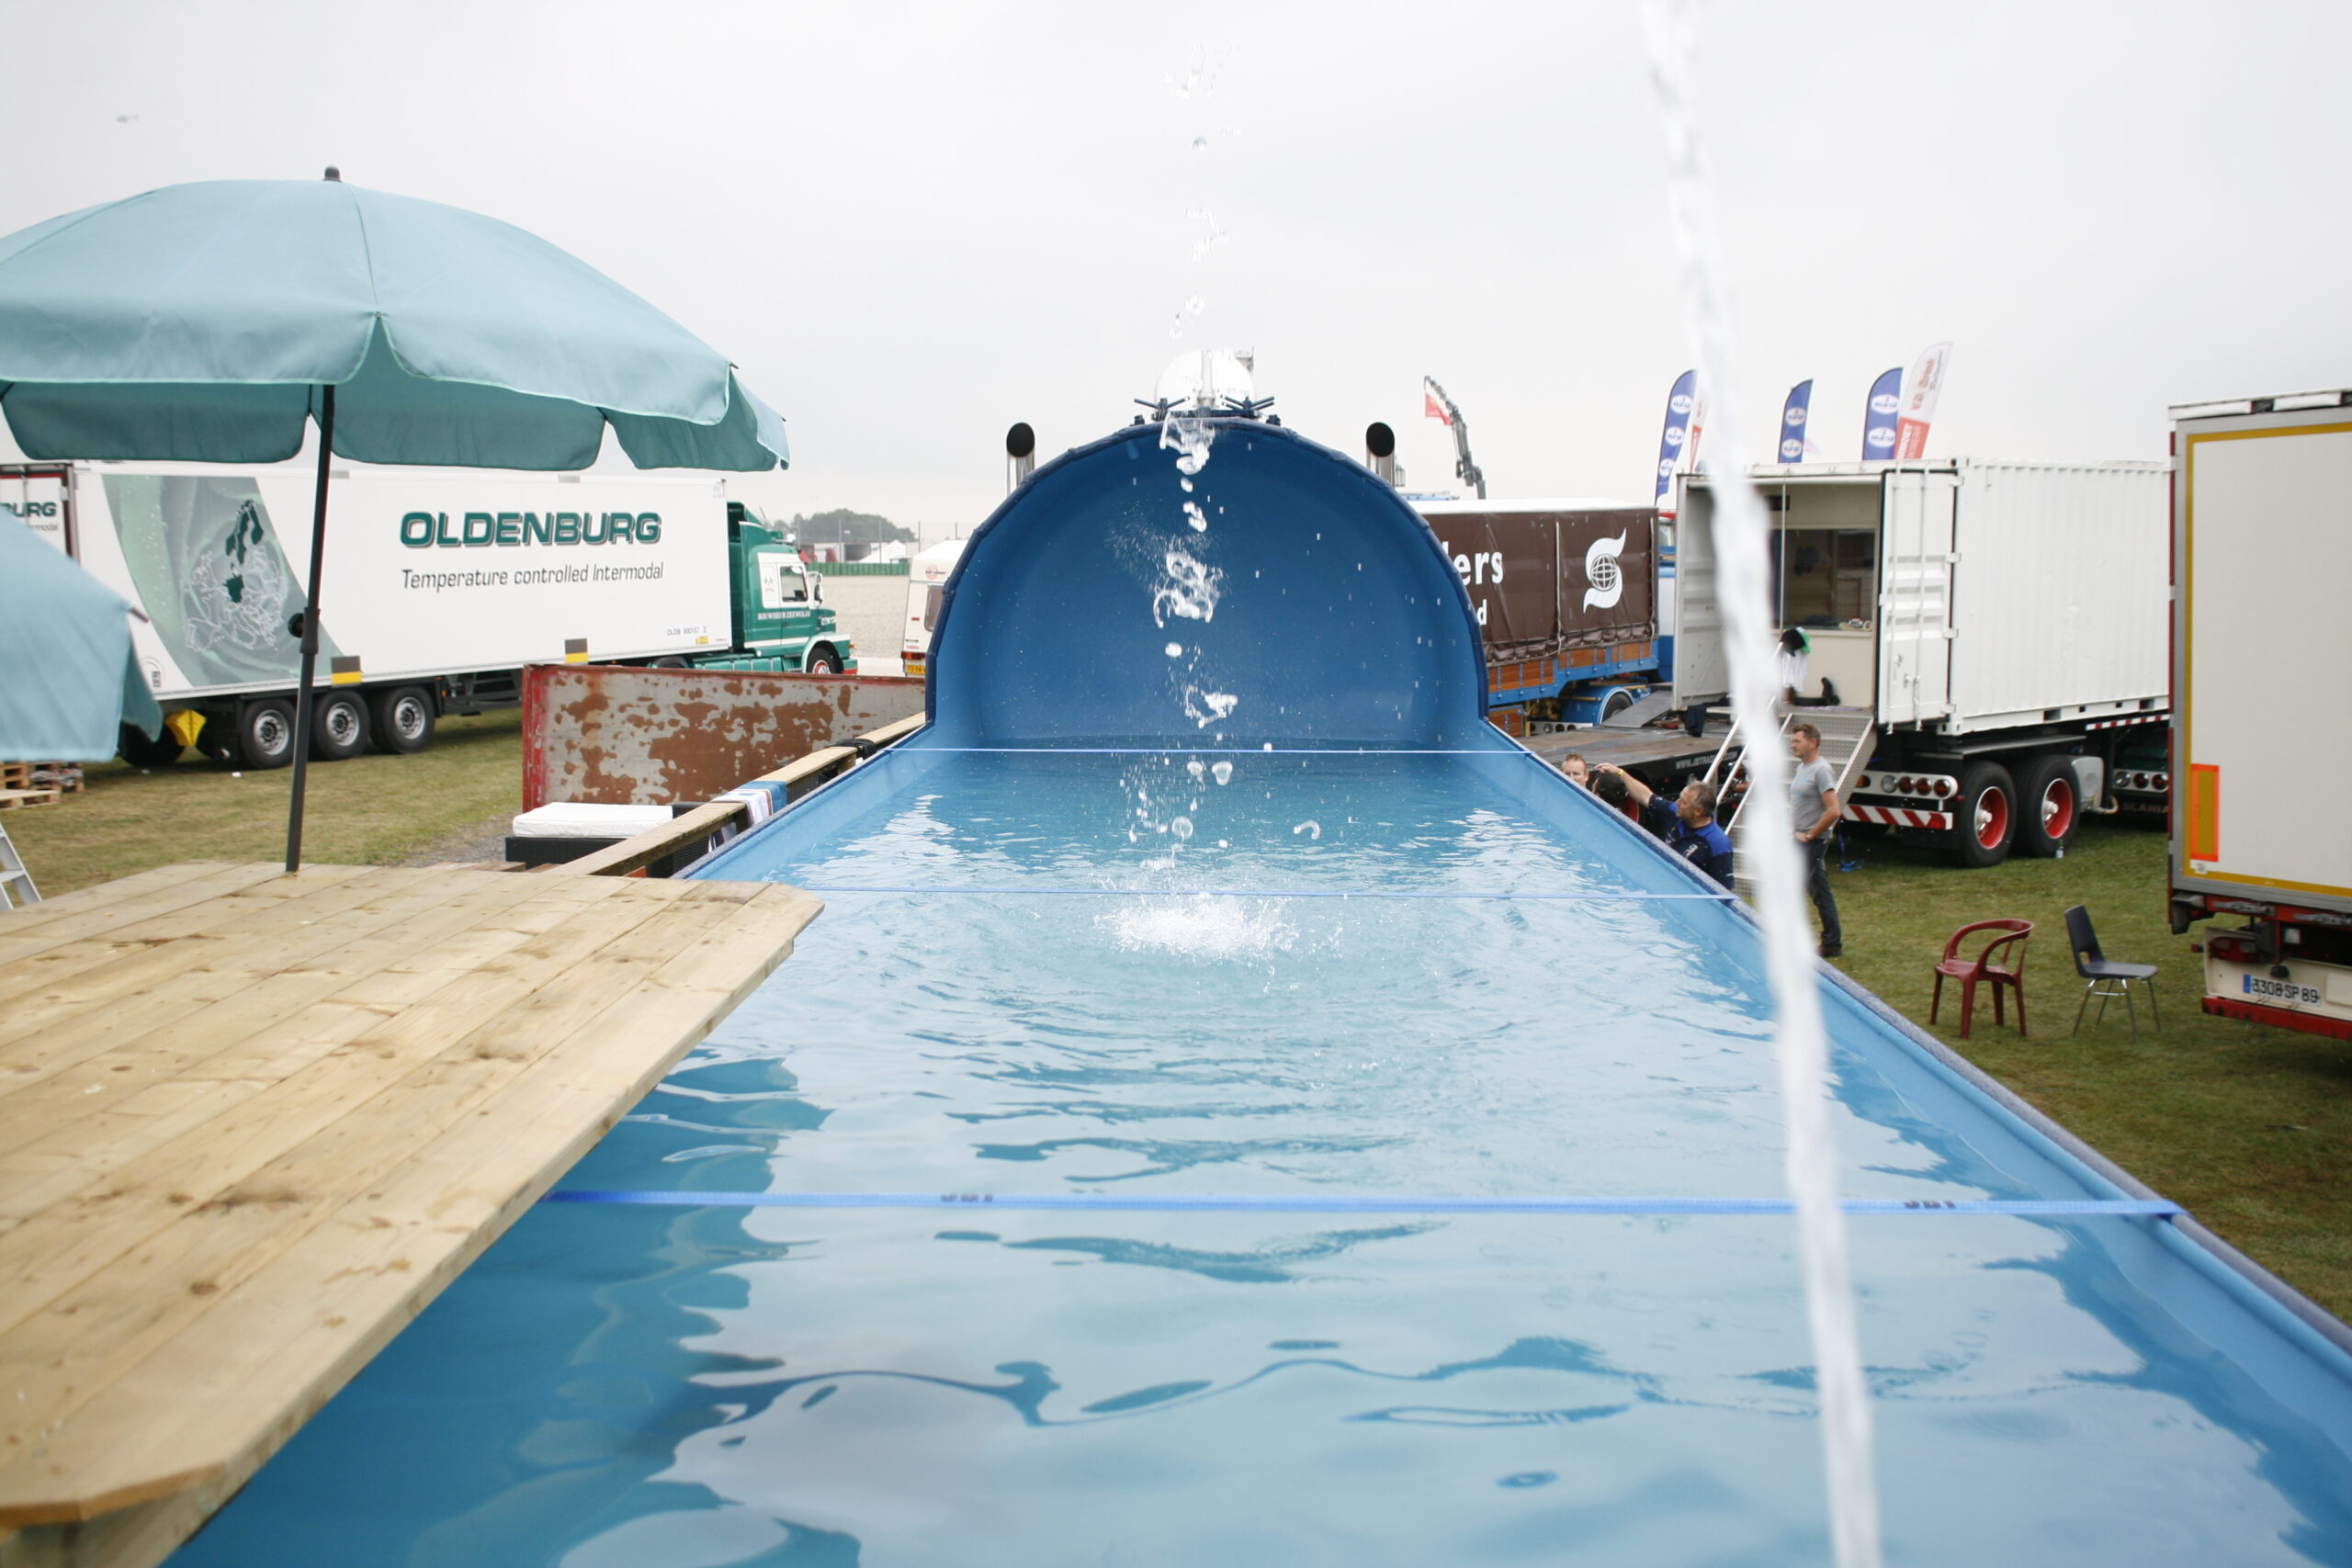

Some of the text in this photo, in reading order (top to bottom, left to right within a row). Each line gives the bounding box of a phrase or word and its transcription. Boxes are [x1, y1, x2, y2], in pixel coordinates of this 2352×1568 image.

[400, 512, 662, 548] OLDENBURG
[401, 561, 664, 593] Temperature controlled Intermodal
